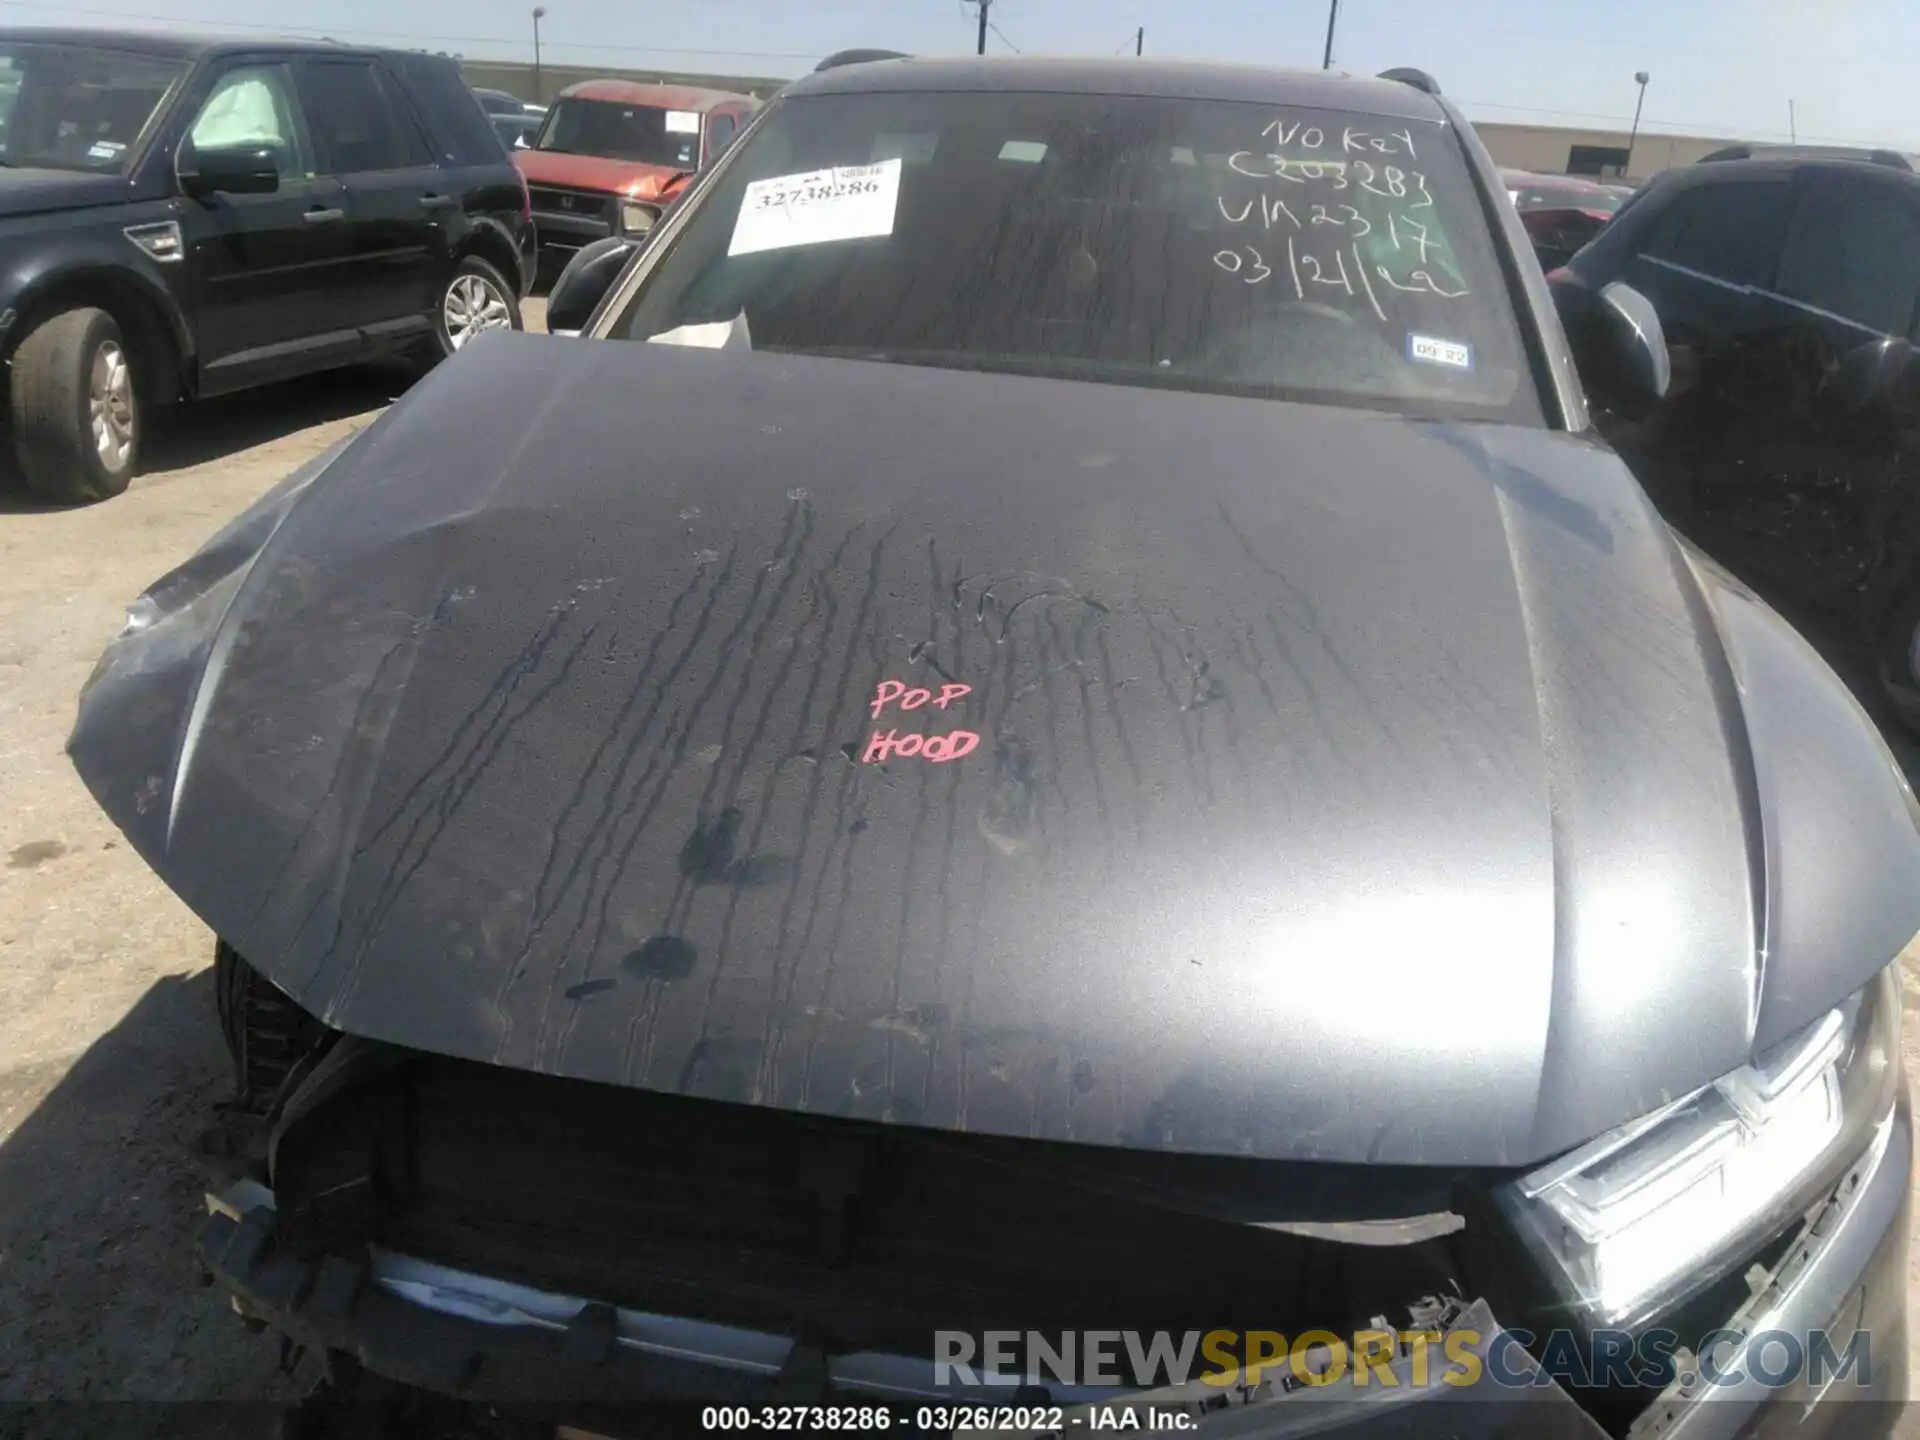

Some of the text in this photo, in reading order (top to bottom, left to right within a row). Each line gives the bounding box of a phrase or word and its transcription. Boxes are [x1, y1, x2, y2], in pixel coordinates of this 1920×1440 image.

[1261, 118, 1324, 148] NO
[761, 180, 879, 207] 32738286
[1311, 204, 1443, 264] 2317
[870, 680, 972, 720] POP
[861, 728, 980, 764] HOOD
